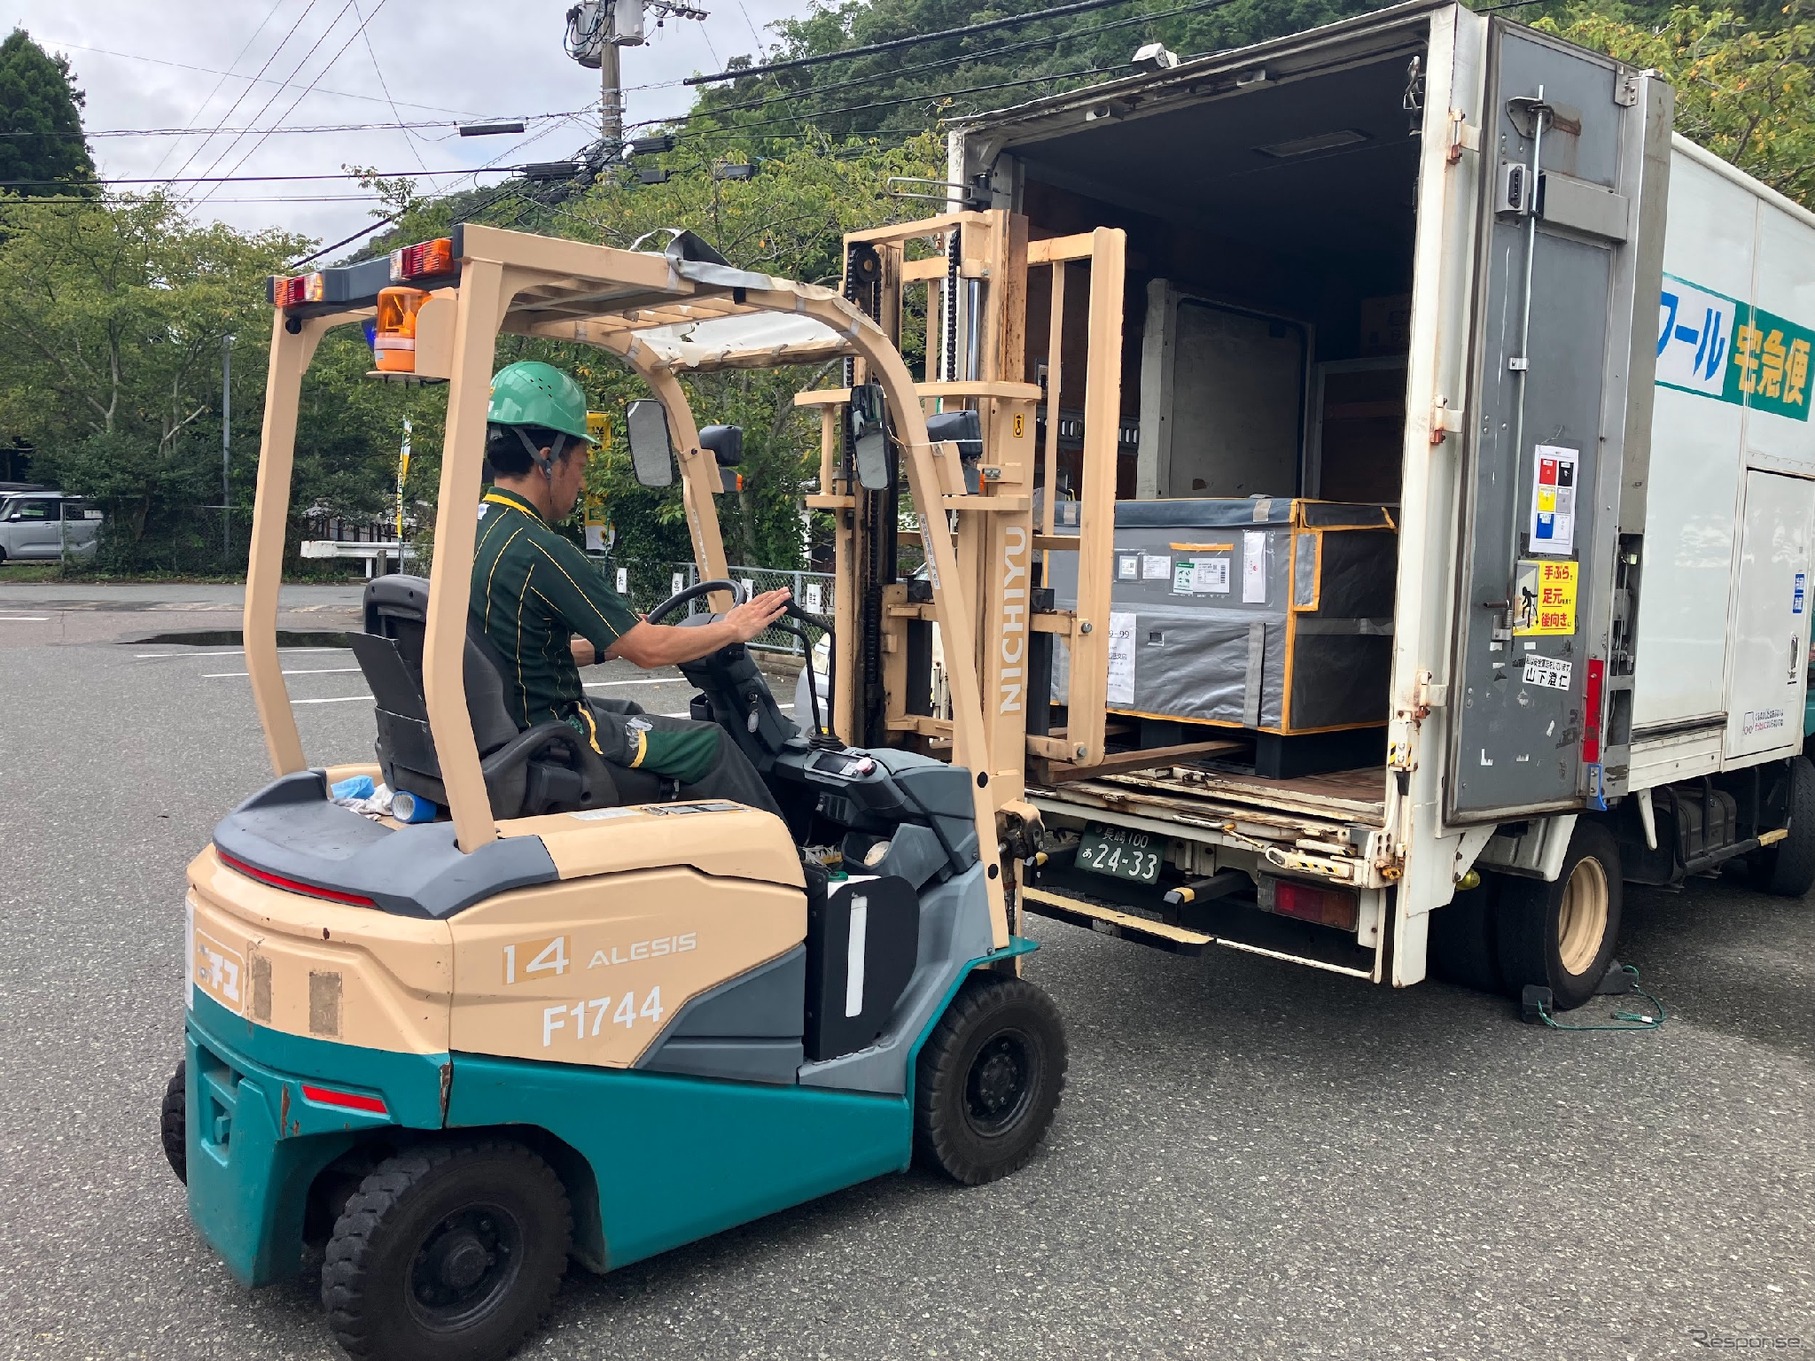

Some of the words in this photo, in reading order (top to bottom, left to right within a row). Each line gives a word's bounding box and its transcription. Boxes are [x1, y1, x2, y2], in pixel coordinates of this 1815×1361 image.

[1734, 319, 1811, 407] 宅急便
[1000, 526, 1027, 716] NICHIYU
[1082, 847, 1094, 860] あ
[1092, 843, 1158, 880] 24-33
[1127, 832, 1149, 849] 100
[503, 935, 570, 985] 14
[587, 931, 698, 970] ALESIS
[542, 985, 664, 1048] F1744
